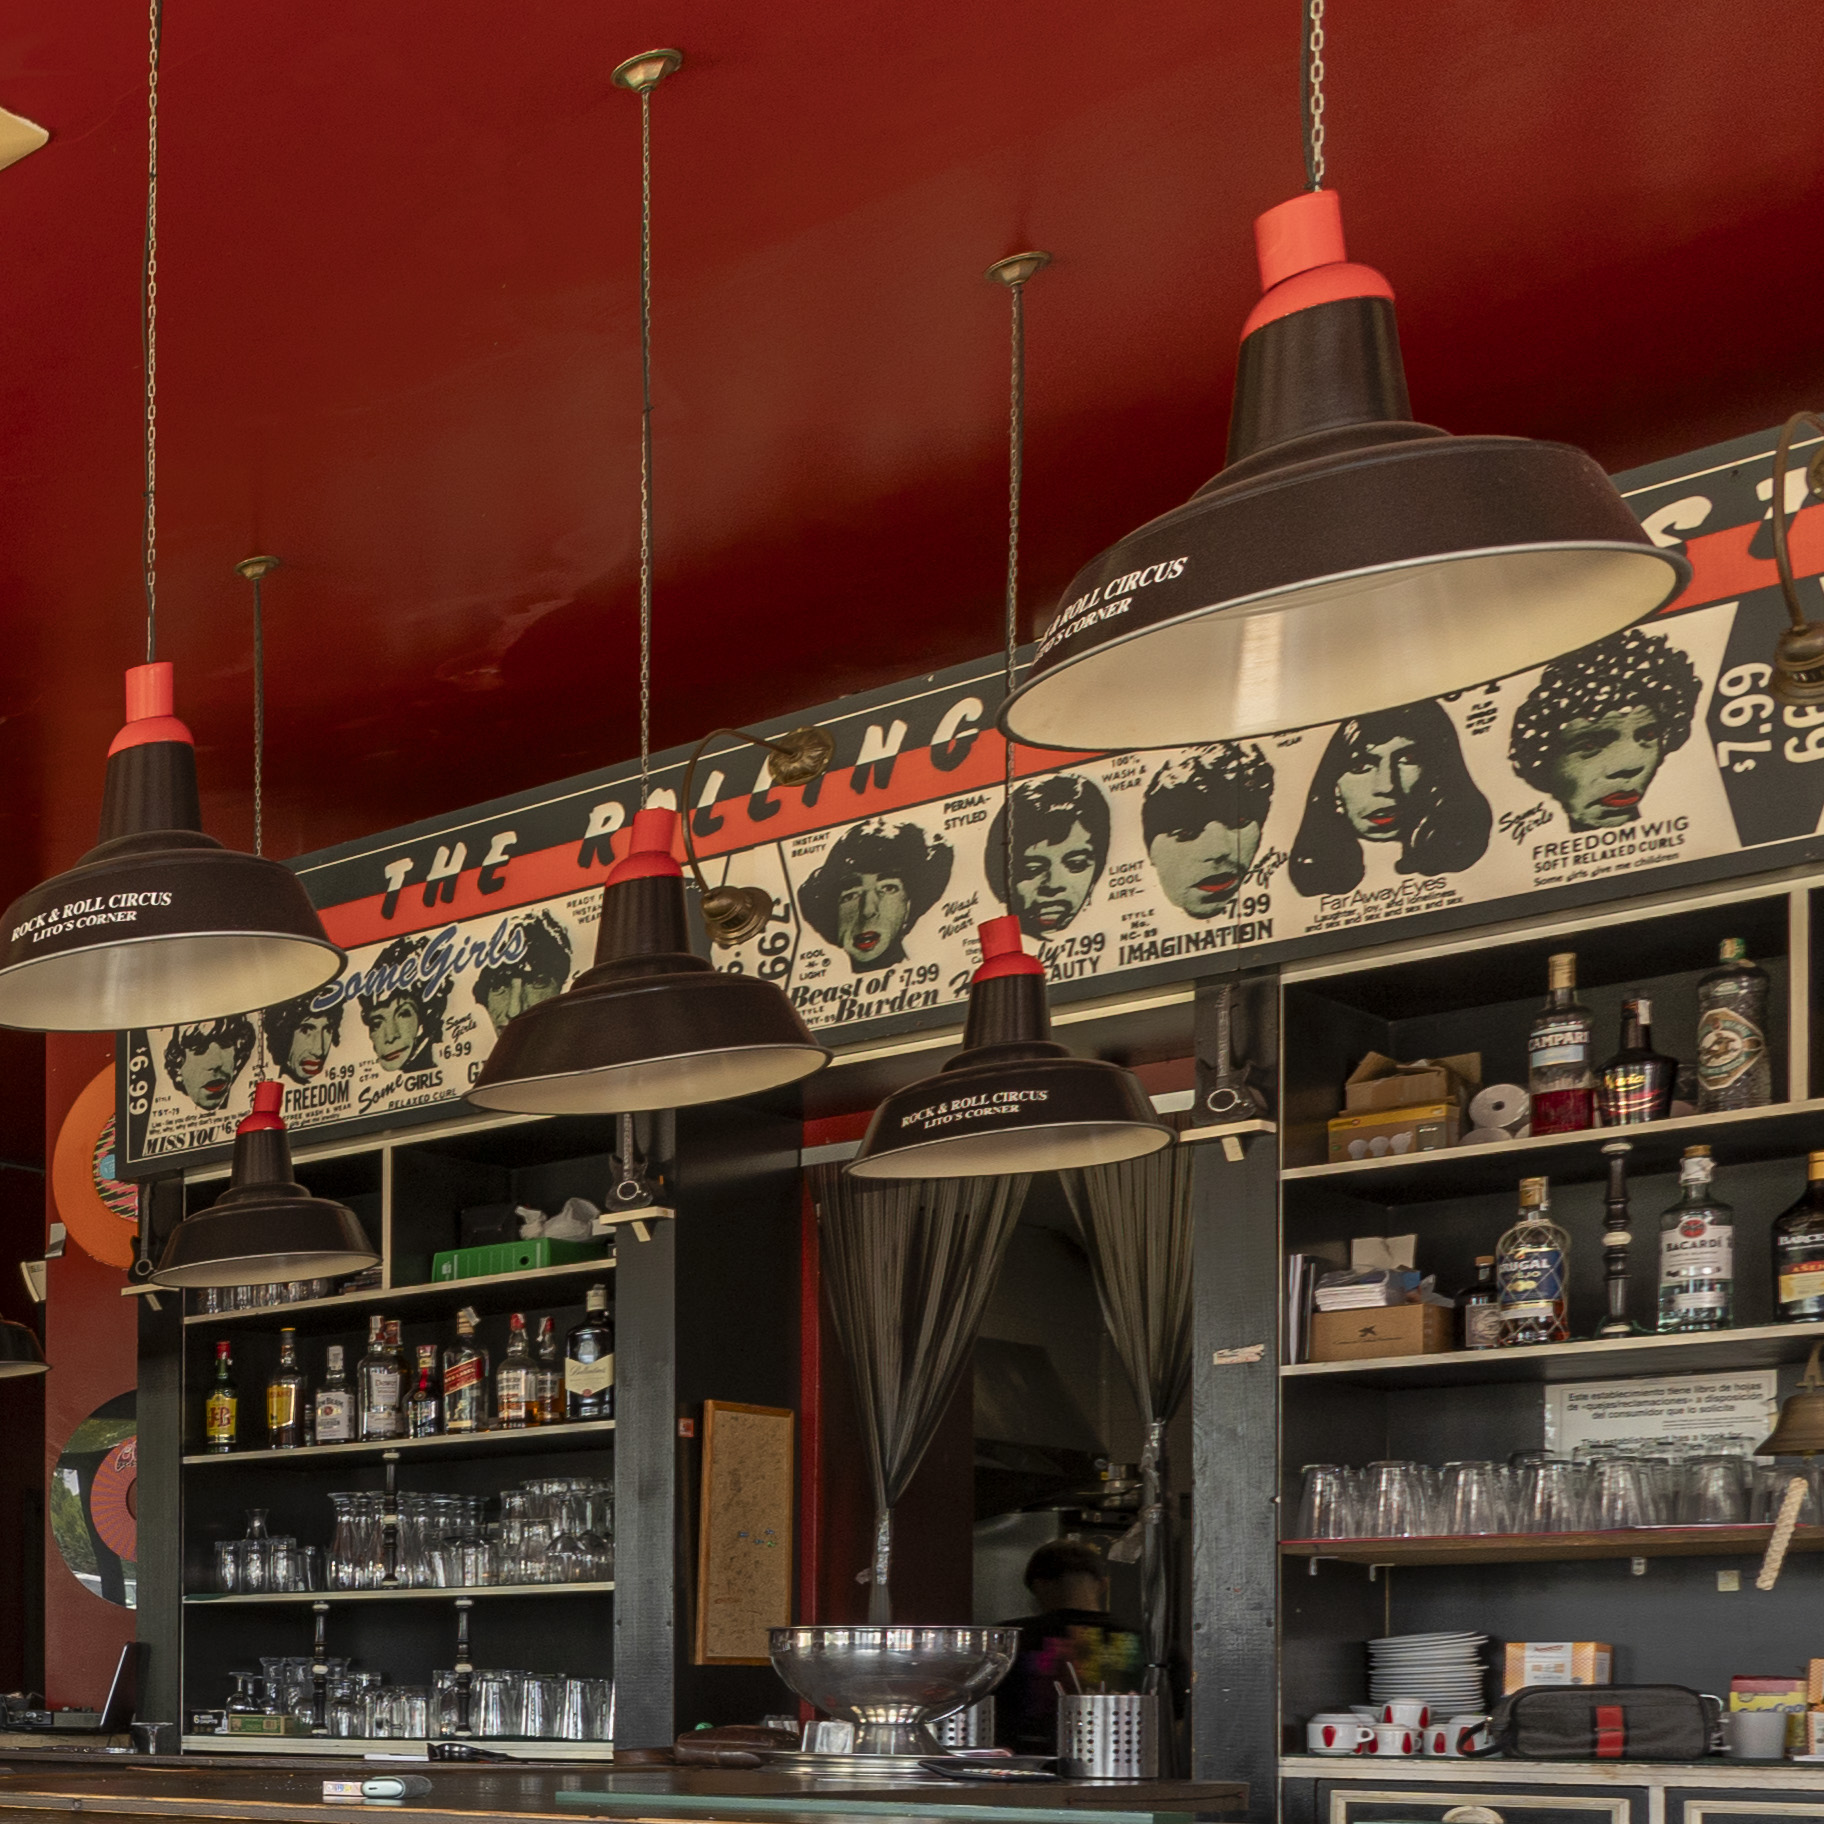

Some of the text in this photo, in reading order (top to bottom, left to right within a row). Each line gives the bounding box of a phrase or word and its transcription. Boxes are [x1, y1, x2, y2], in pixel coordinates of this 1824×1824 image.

[1103, 556, 1189, 601] CIRCUS
[1063, 597, 1133, 641] CORNER
[1532, 816, 1689, 861] FREEDOM WIG
[1534, 834, 1685, 873] SOFT RELAXED CURLS
[381, 830, 517, 921] THE
[11, 891, 173, 942] ROCK & ROLL CIRCUS
[76, 910, 138, 930] CORNER
[412, 916, 529, 1005] Girls
[1118, 918, 1274, 966] IMAGINATION
[790, 969, 896, 1009] Beast of
[833, 988, 940, 1023] Burden
[1528, 1030, 1590, 1052] CAMPARI
[284, 1079, 350, 1113] FREEDOM
[357, 1069, 444, 1115] Some GIRLS
[141, 1125, 221, 1157] MISS YOU
[1568, 1382, 1761, 1401] Este establecimiento tiene libro de hojas
